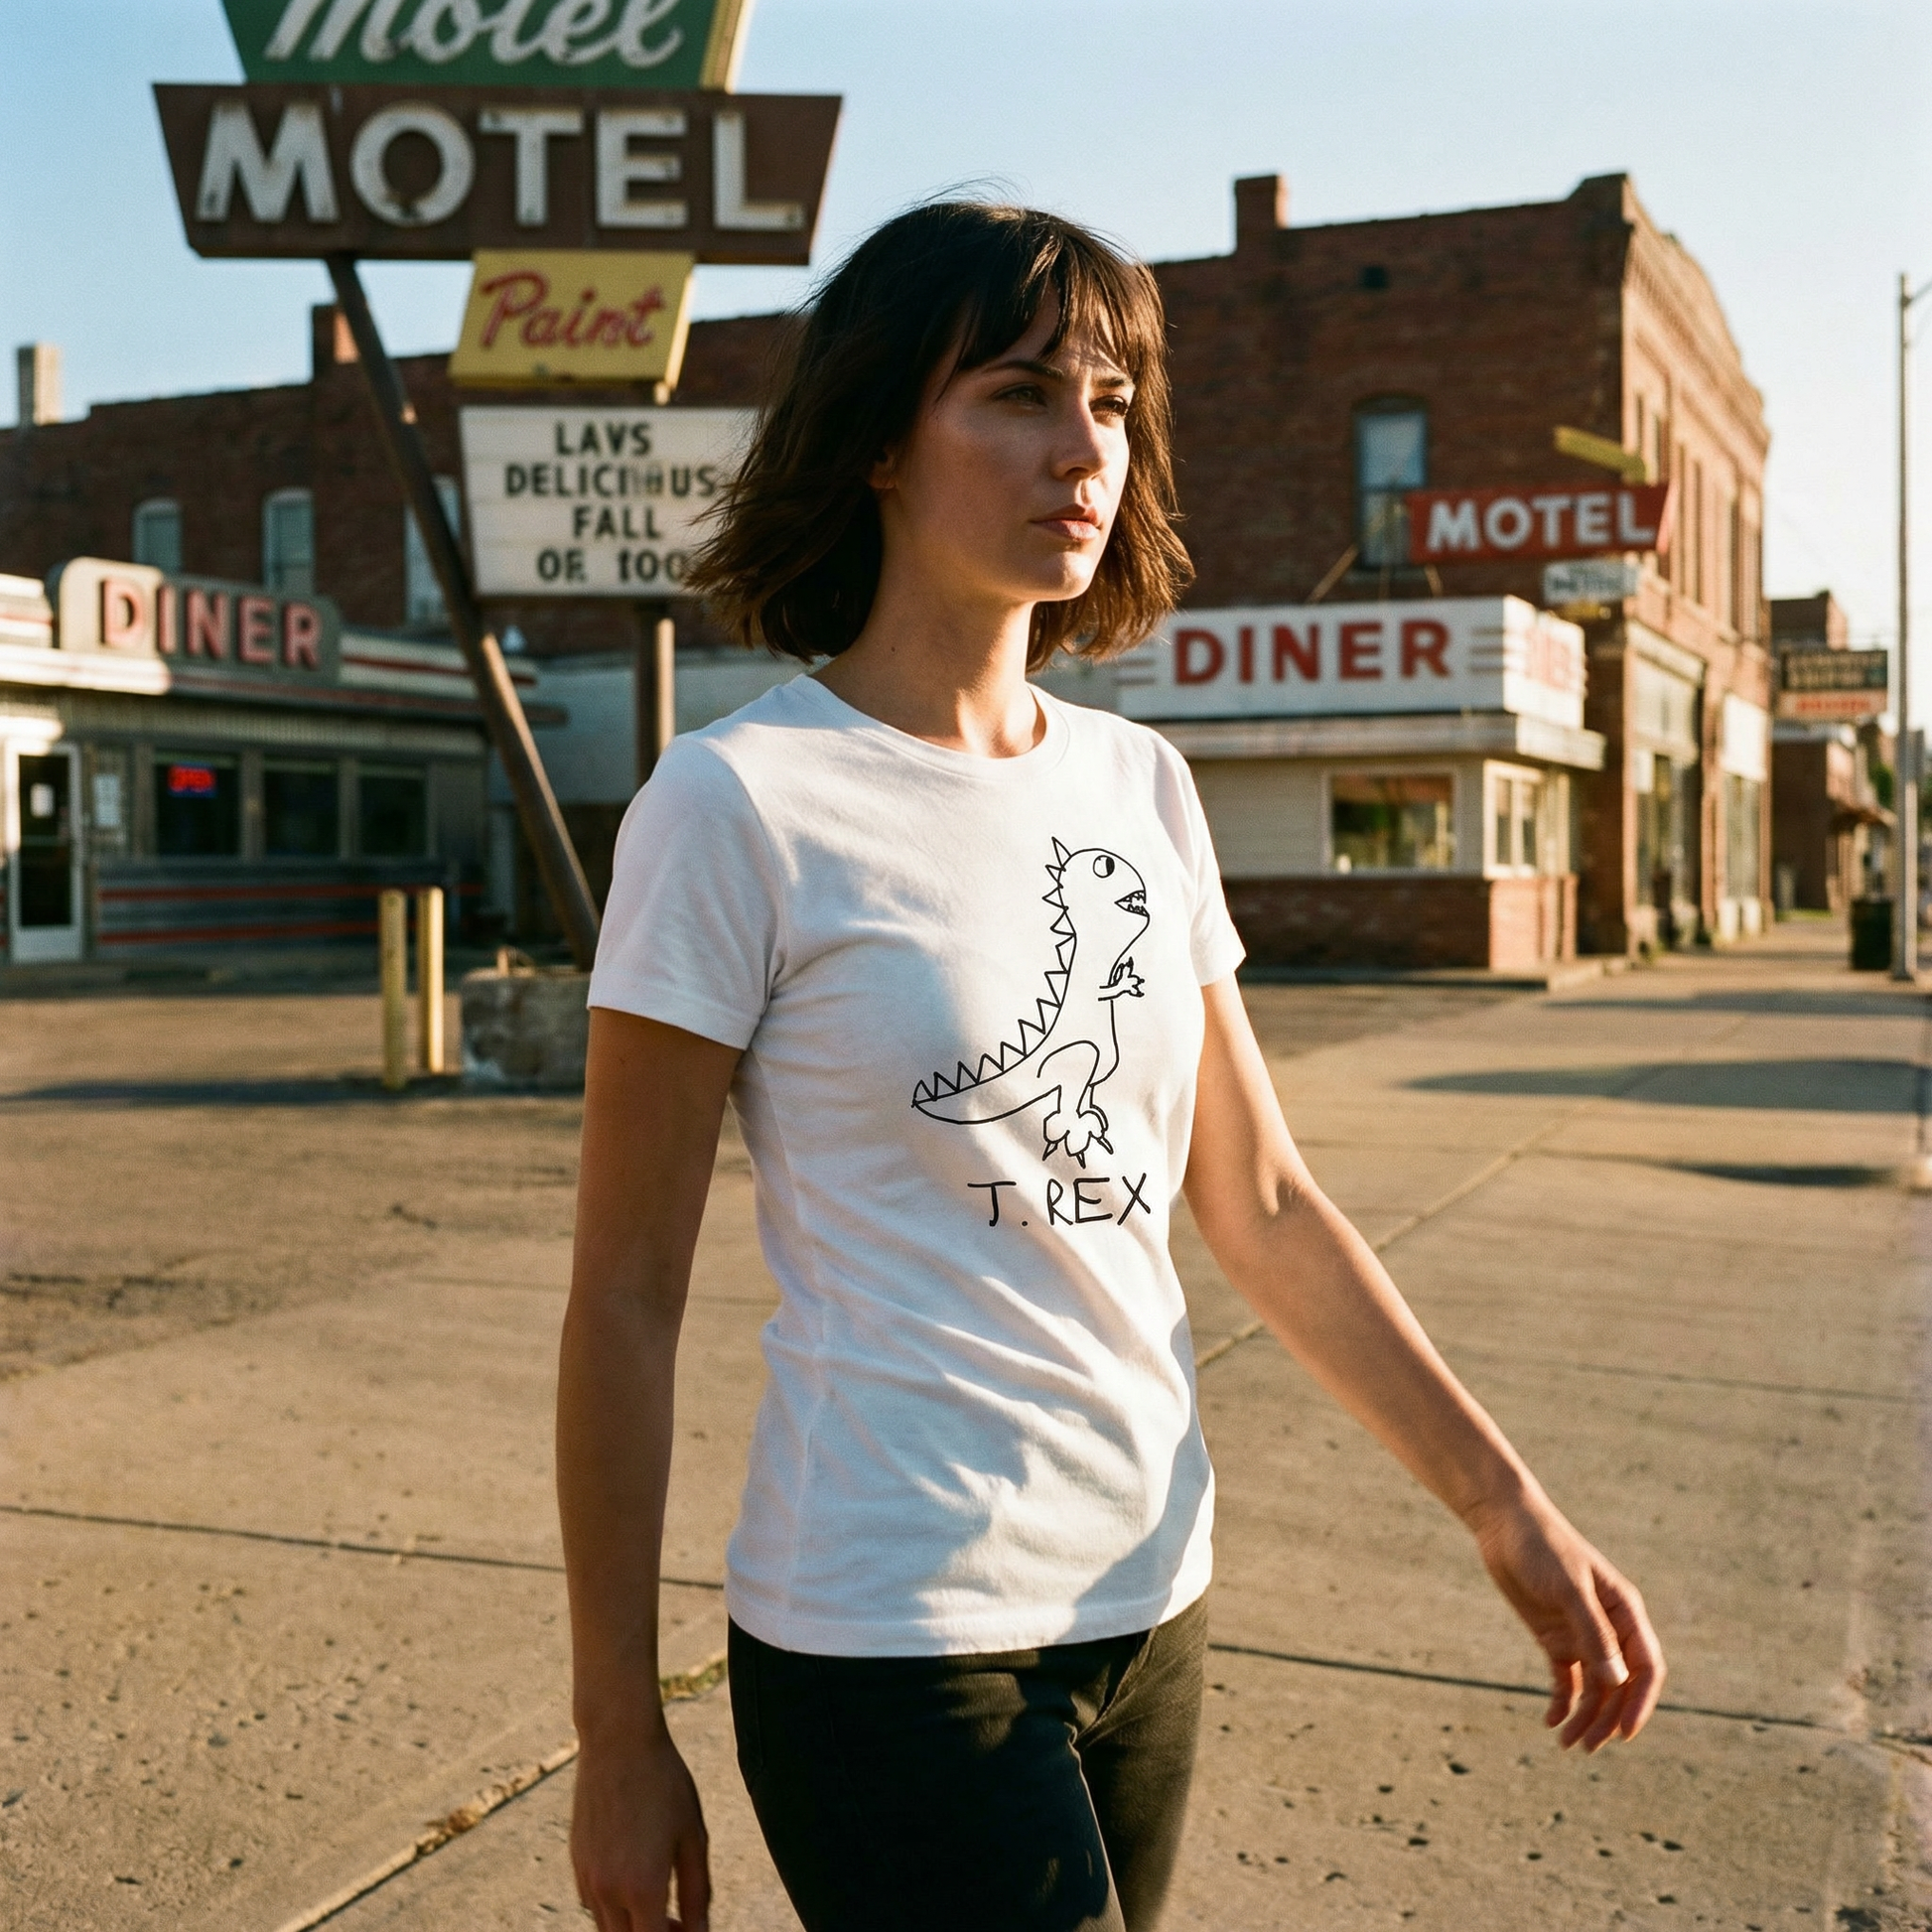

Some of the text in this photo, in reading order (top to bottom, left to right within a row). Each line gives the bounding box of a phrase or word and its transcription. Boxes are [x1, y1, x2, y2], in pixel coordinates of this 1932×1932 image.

[197, 100, 806, 229] MOTEL
[573, 504, 661, 539] FALL
[1426, 491, 1655, 553] MOTEL
[101, 578, 323, 669] DINER
[1173, 619, 1453, 687] DINER
[967, 1173, 1152, 1227] T. REX
